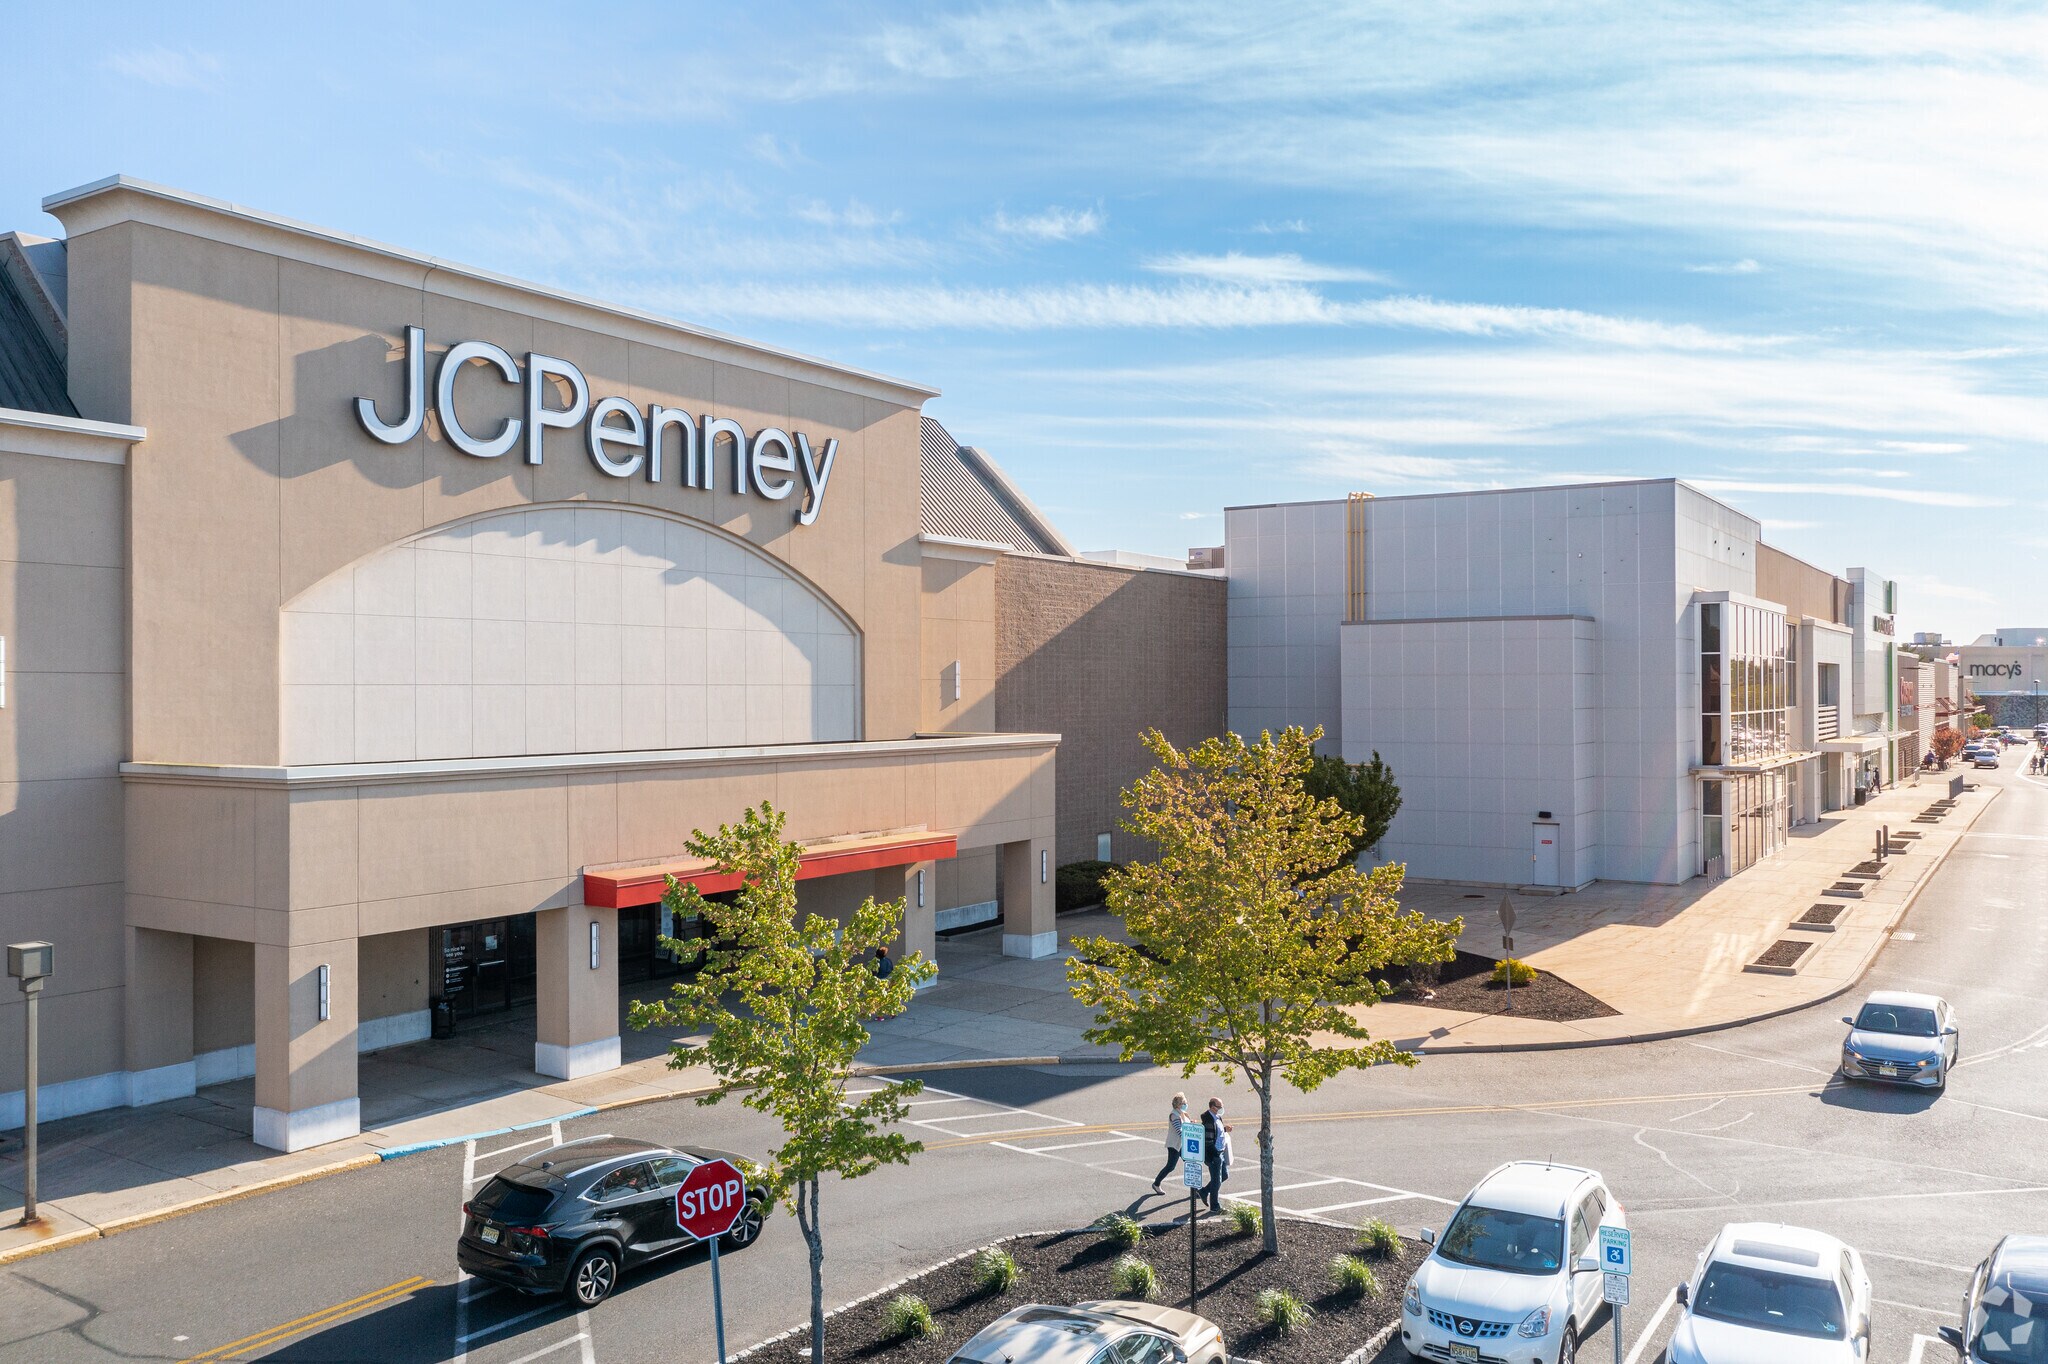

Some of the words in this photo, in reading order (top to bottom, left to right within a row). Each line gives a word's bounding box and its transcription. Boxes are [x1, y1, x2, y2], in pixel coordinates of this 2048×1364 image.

[353, 323, 839, 526] JCPenney
[1970, 660, 2022, 680] macy's
[681, 1179, 740, 1220] STOP
[1600, 1229, 1628, 1240] RESERVED
[1602, 1237, 1627, 1248] PARKING
